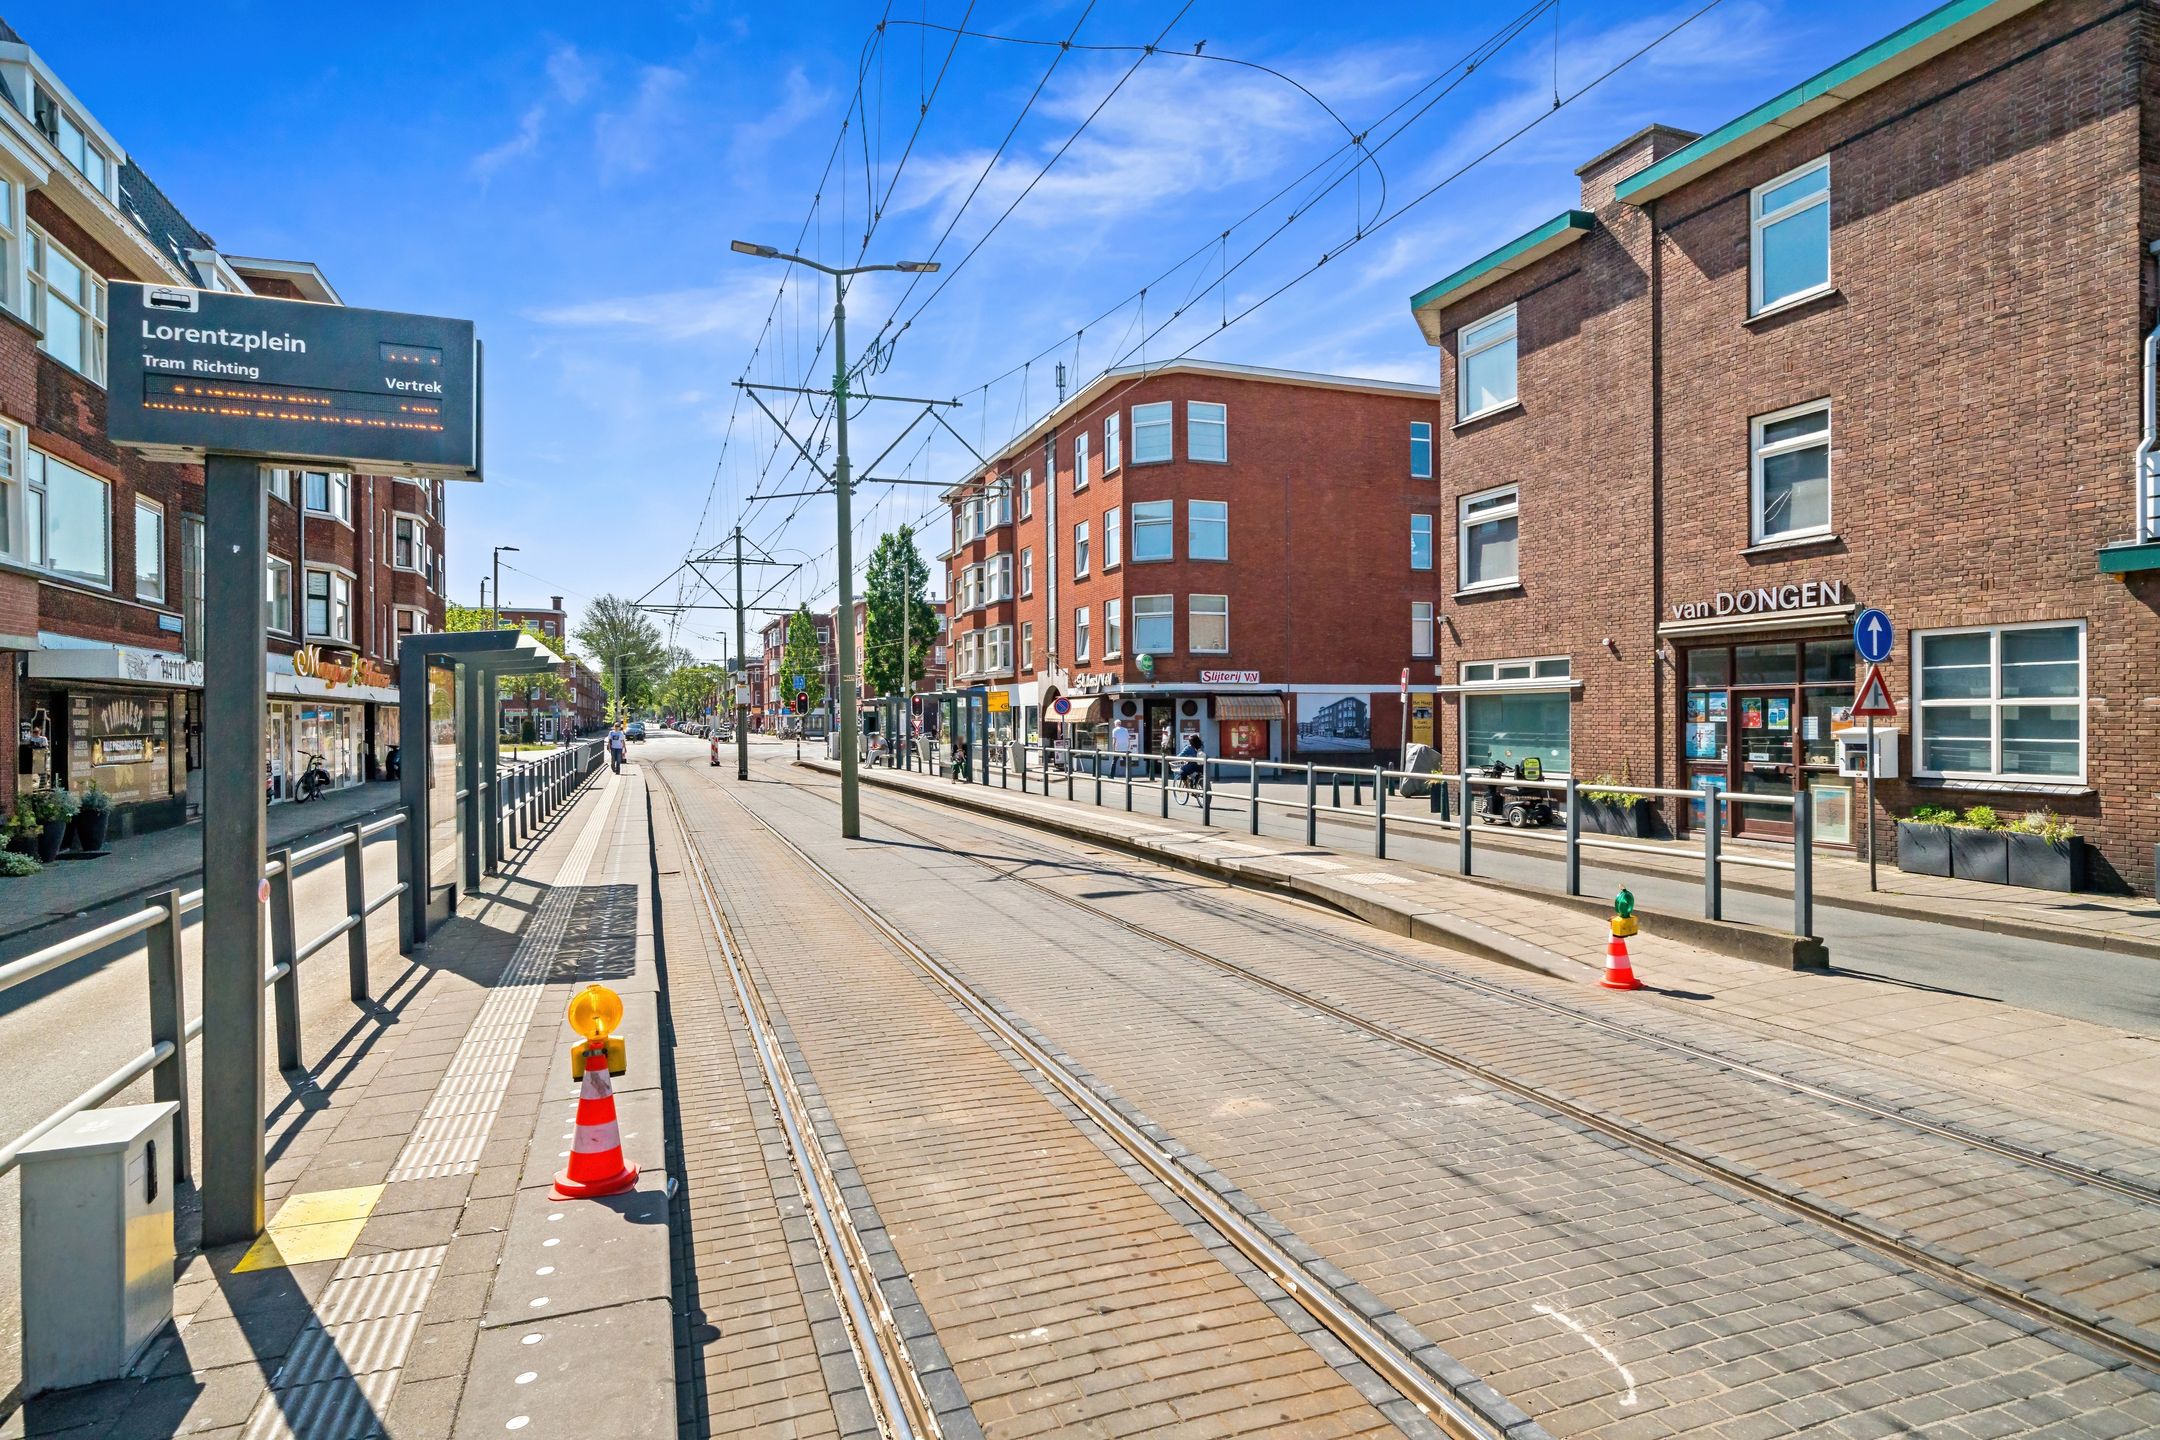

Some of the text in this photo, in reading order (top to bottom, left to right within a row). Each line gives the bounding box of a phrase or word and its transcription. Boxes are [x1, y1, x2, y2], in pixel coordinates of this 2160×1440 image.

[142, 319, 306, 353] Lorentzplein
[143, 354, 260, 379] Tram Richting
[385, 377, 443, 394] Vertrek
[1672, 580, 1842, 619] van DONGEN
[1202, 671, 1242, 683] Slijterij
